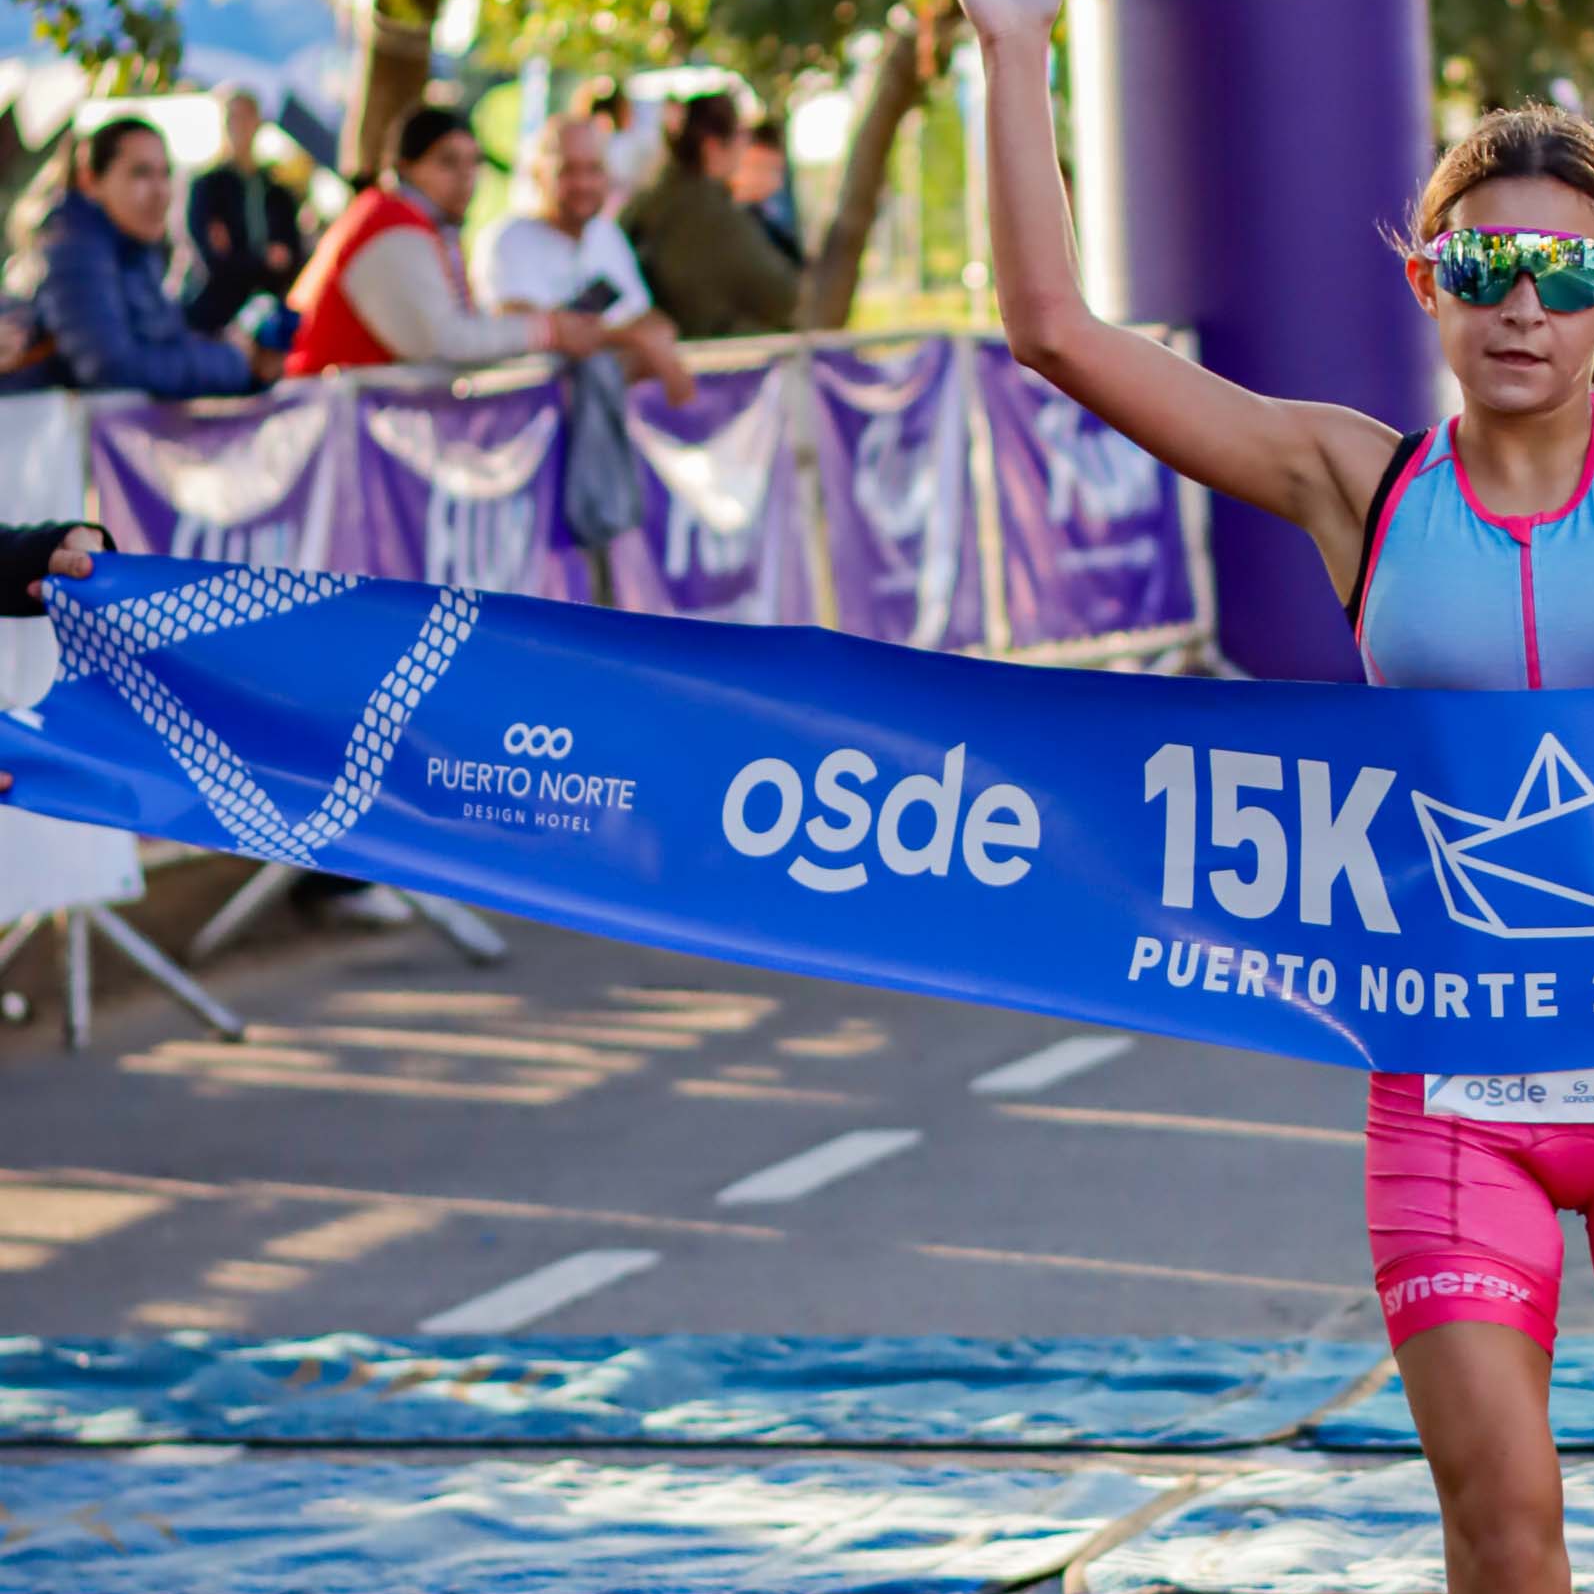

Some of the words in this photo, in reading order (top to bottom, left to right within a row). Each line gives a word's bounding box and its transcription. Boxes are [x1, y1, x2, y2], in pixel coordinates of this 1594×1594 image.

[427, 756, 532, 798] PUERTO
[538, 770, 637, 810] NORTE
[463, 802, 526, 824] DESIGN
[534, 812, 592, 833] HOTEL
[721, 741, 1041, 893] osde
[1143, 742, 1402, 935] 15K
[1128, 936, 1338, 1006] PUERTO
[1359, 965, 1559, 1019] NORTE
[1464, 1076, 1547, 1106] osde
[1384, 1271, 1531, 1317] synergy
